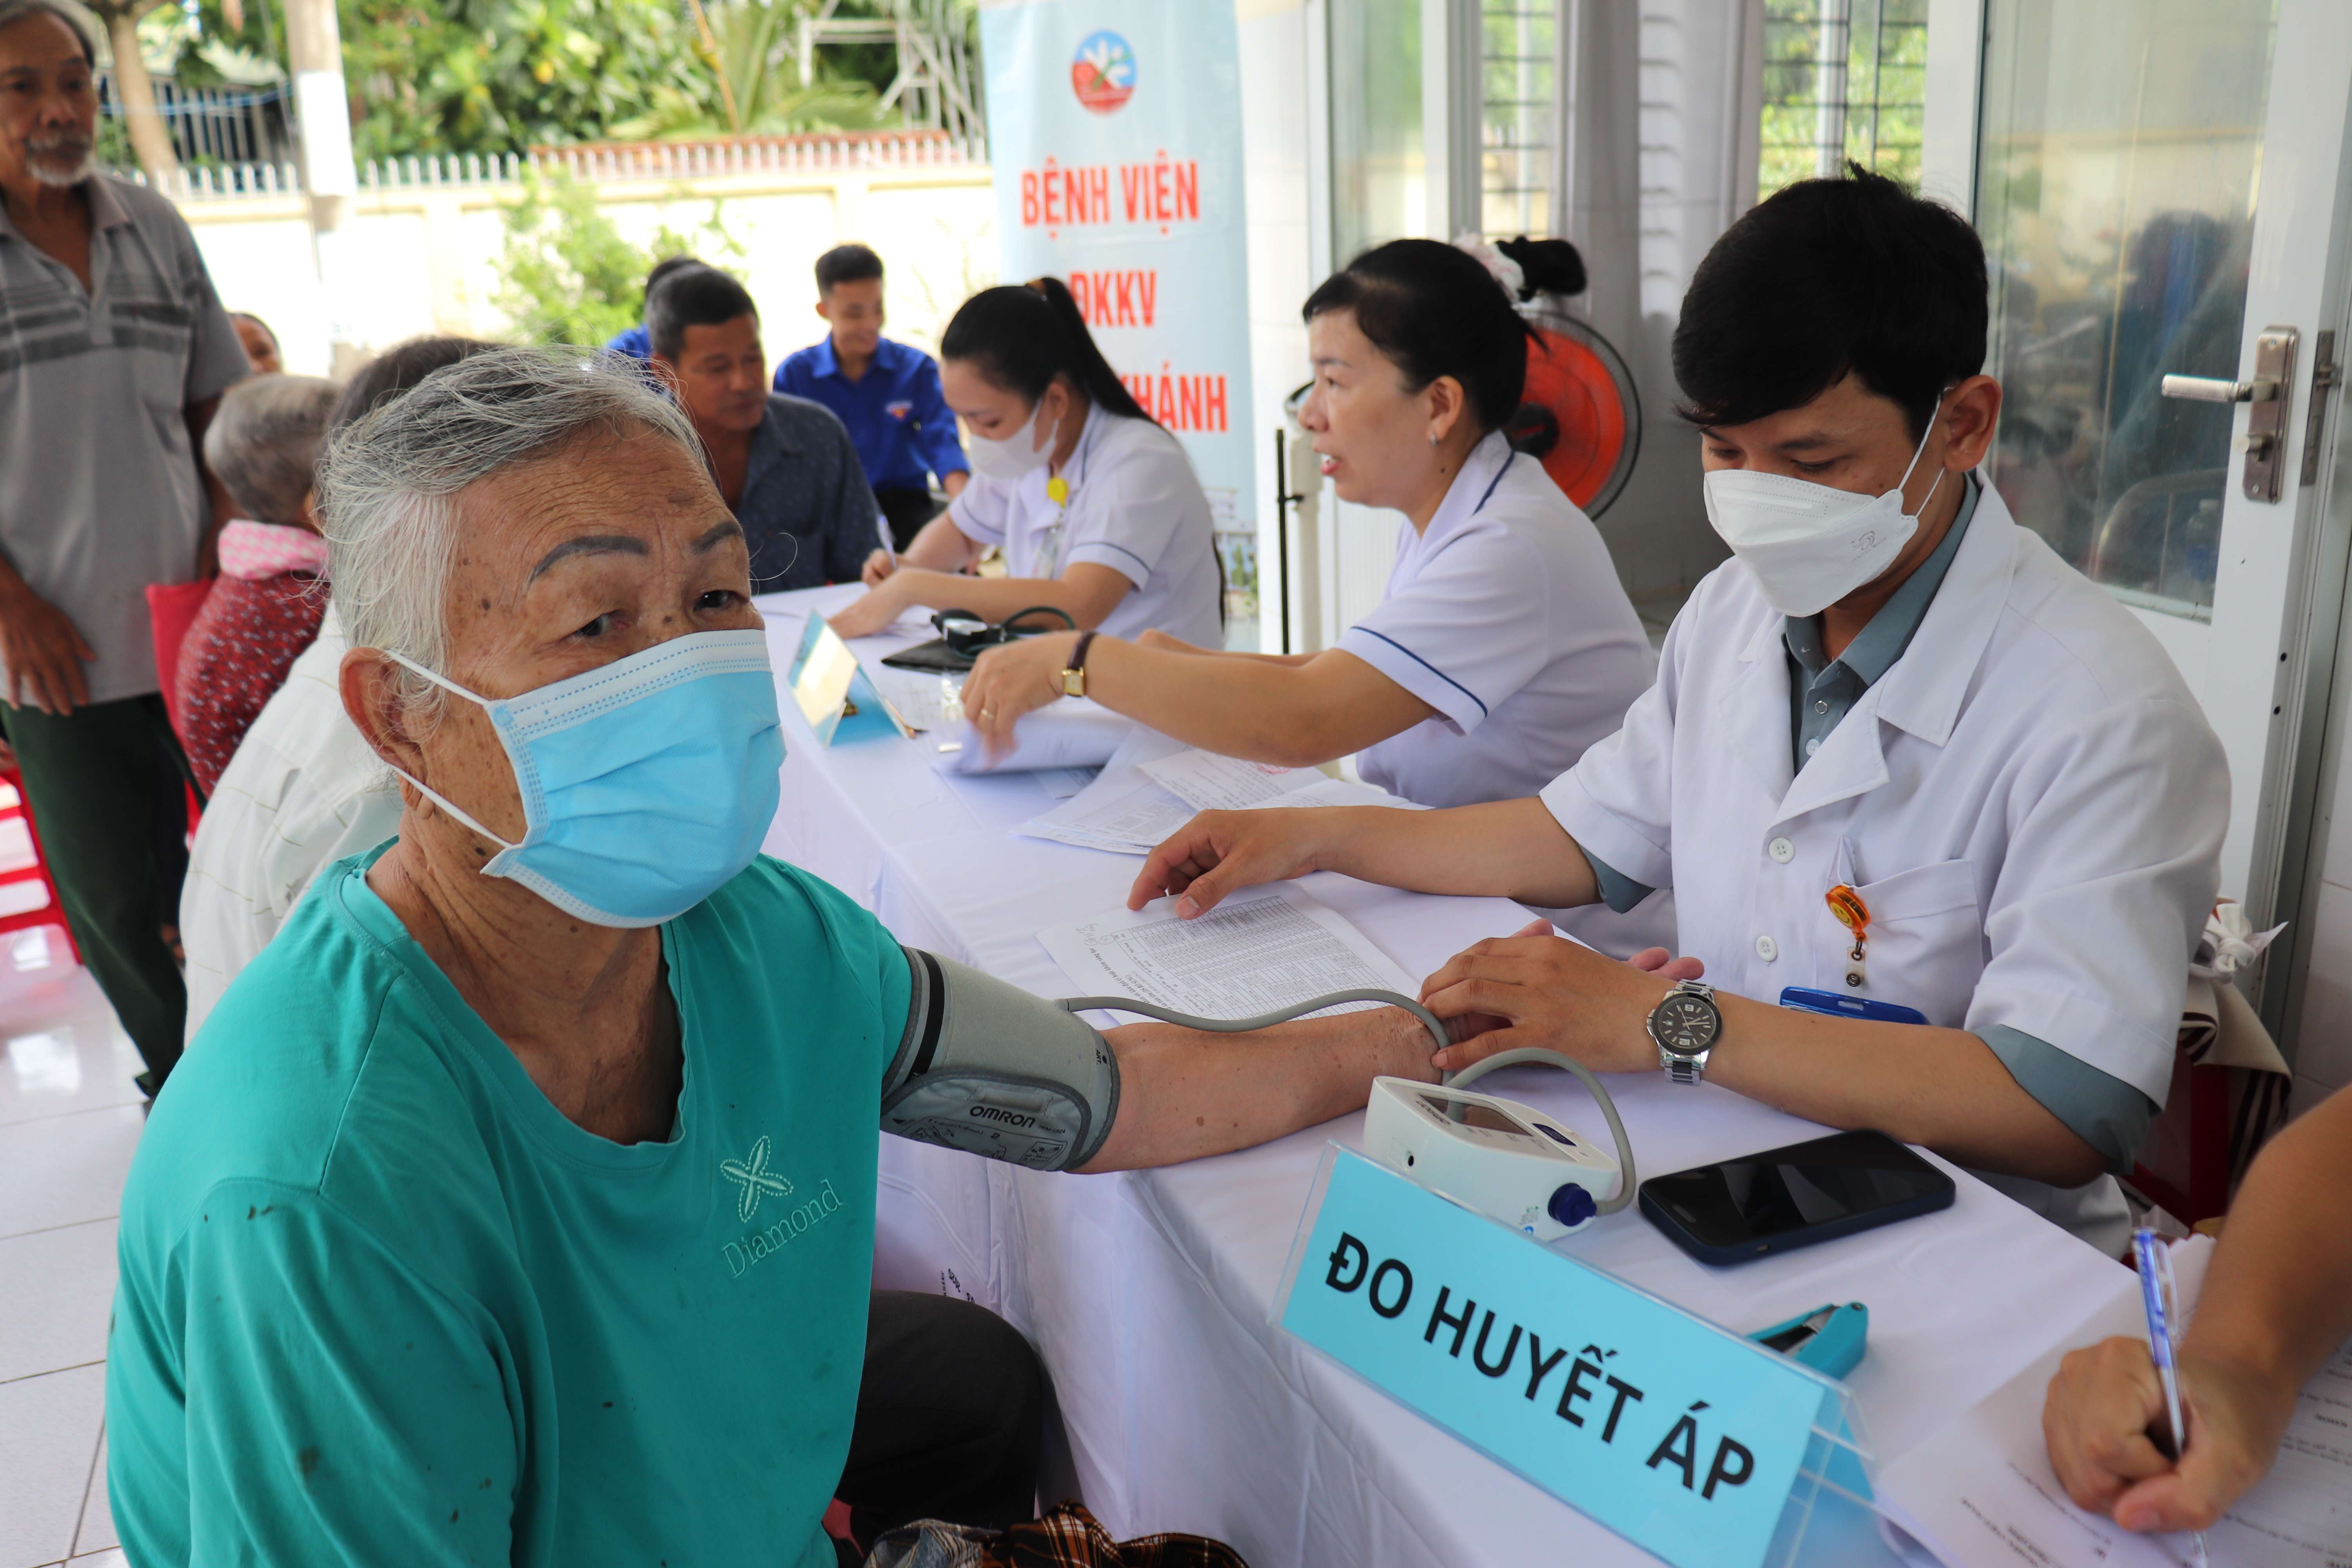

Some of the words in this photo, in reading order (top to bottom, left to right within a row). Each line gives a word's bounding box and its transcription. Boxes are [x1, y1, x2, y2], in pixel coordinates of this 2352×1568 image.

[1021, 156, 1111, 239] BỆNH
[1120, 150, 1200, 235] VIỆN
[1118, 361, 1229, 433] HÁNH
[969, 1105, 1036, 1128] OMRON
[721, 1178, 844, 1279] Diamond
[1325, 1232, 1413, 1319] ĐO
[1424, 1285, 1643, 1443] HUYẾT
[1646, 1400, 1754, 1500] ÁP
